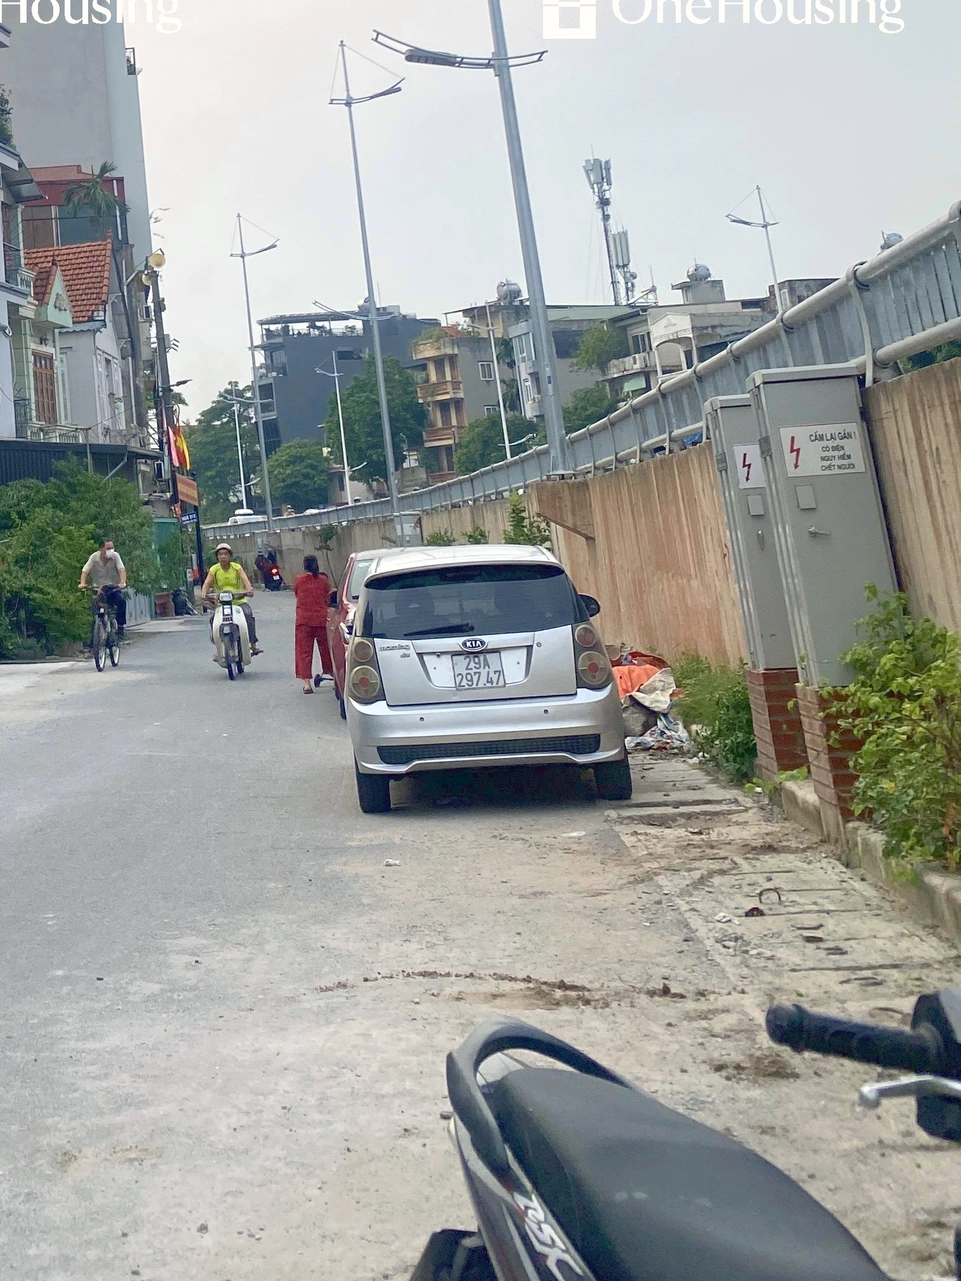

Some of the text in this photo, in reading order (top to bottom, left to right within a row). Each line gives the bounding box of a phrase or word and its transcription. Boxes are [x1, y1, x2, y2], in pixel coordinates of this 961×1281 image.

[809, 431, 824, 443] CẤM
[826, 433, 837, 443] LẠI
[821, 462, 836, 471] CHẾT
[466, 641, 482, 649] KIA
[464, 656, 491, 671] 29A
[456, 670, 502, 688] 297.47
